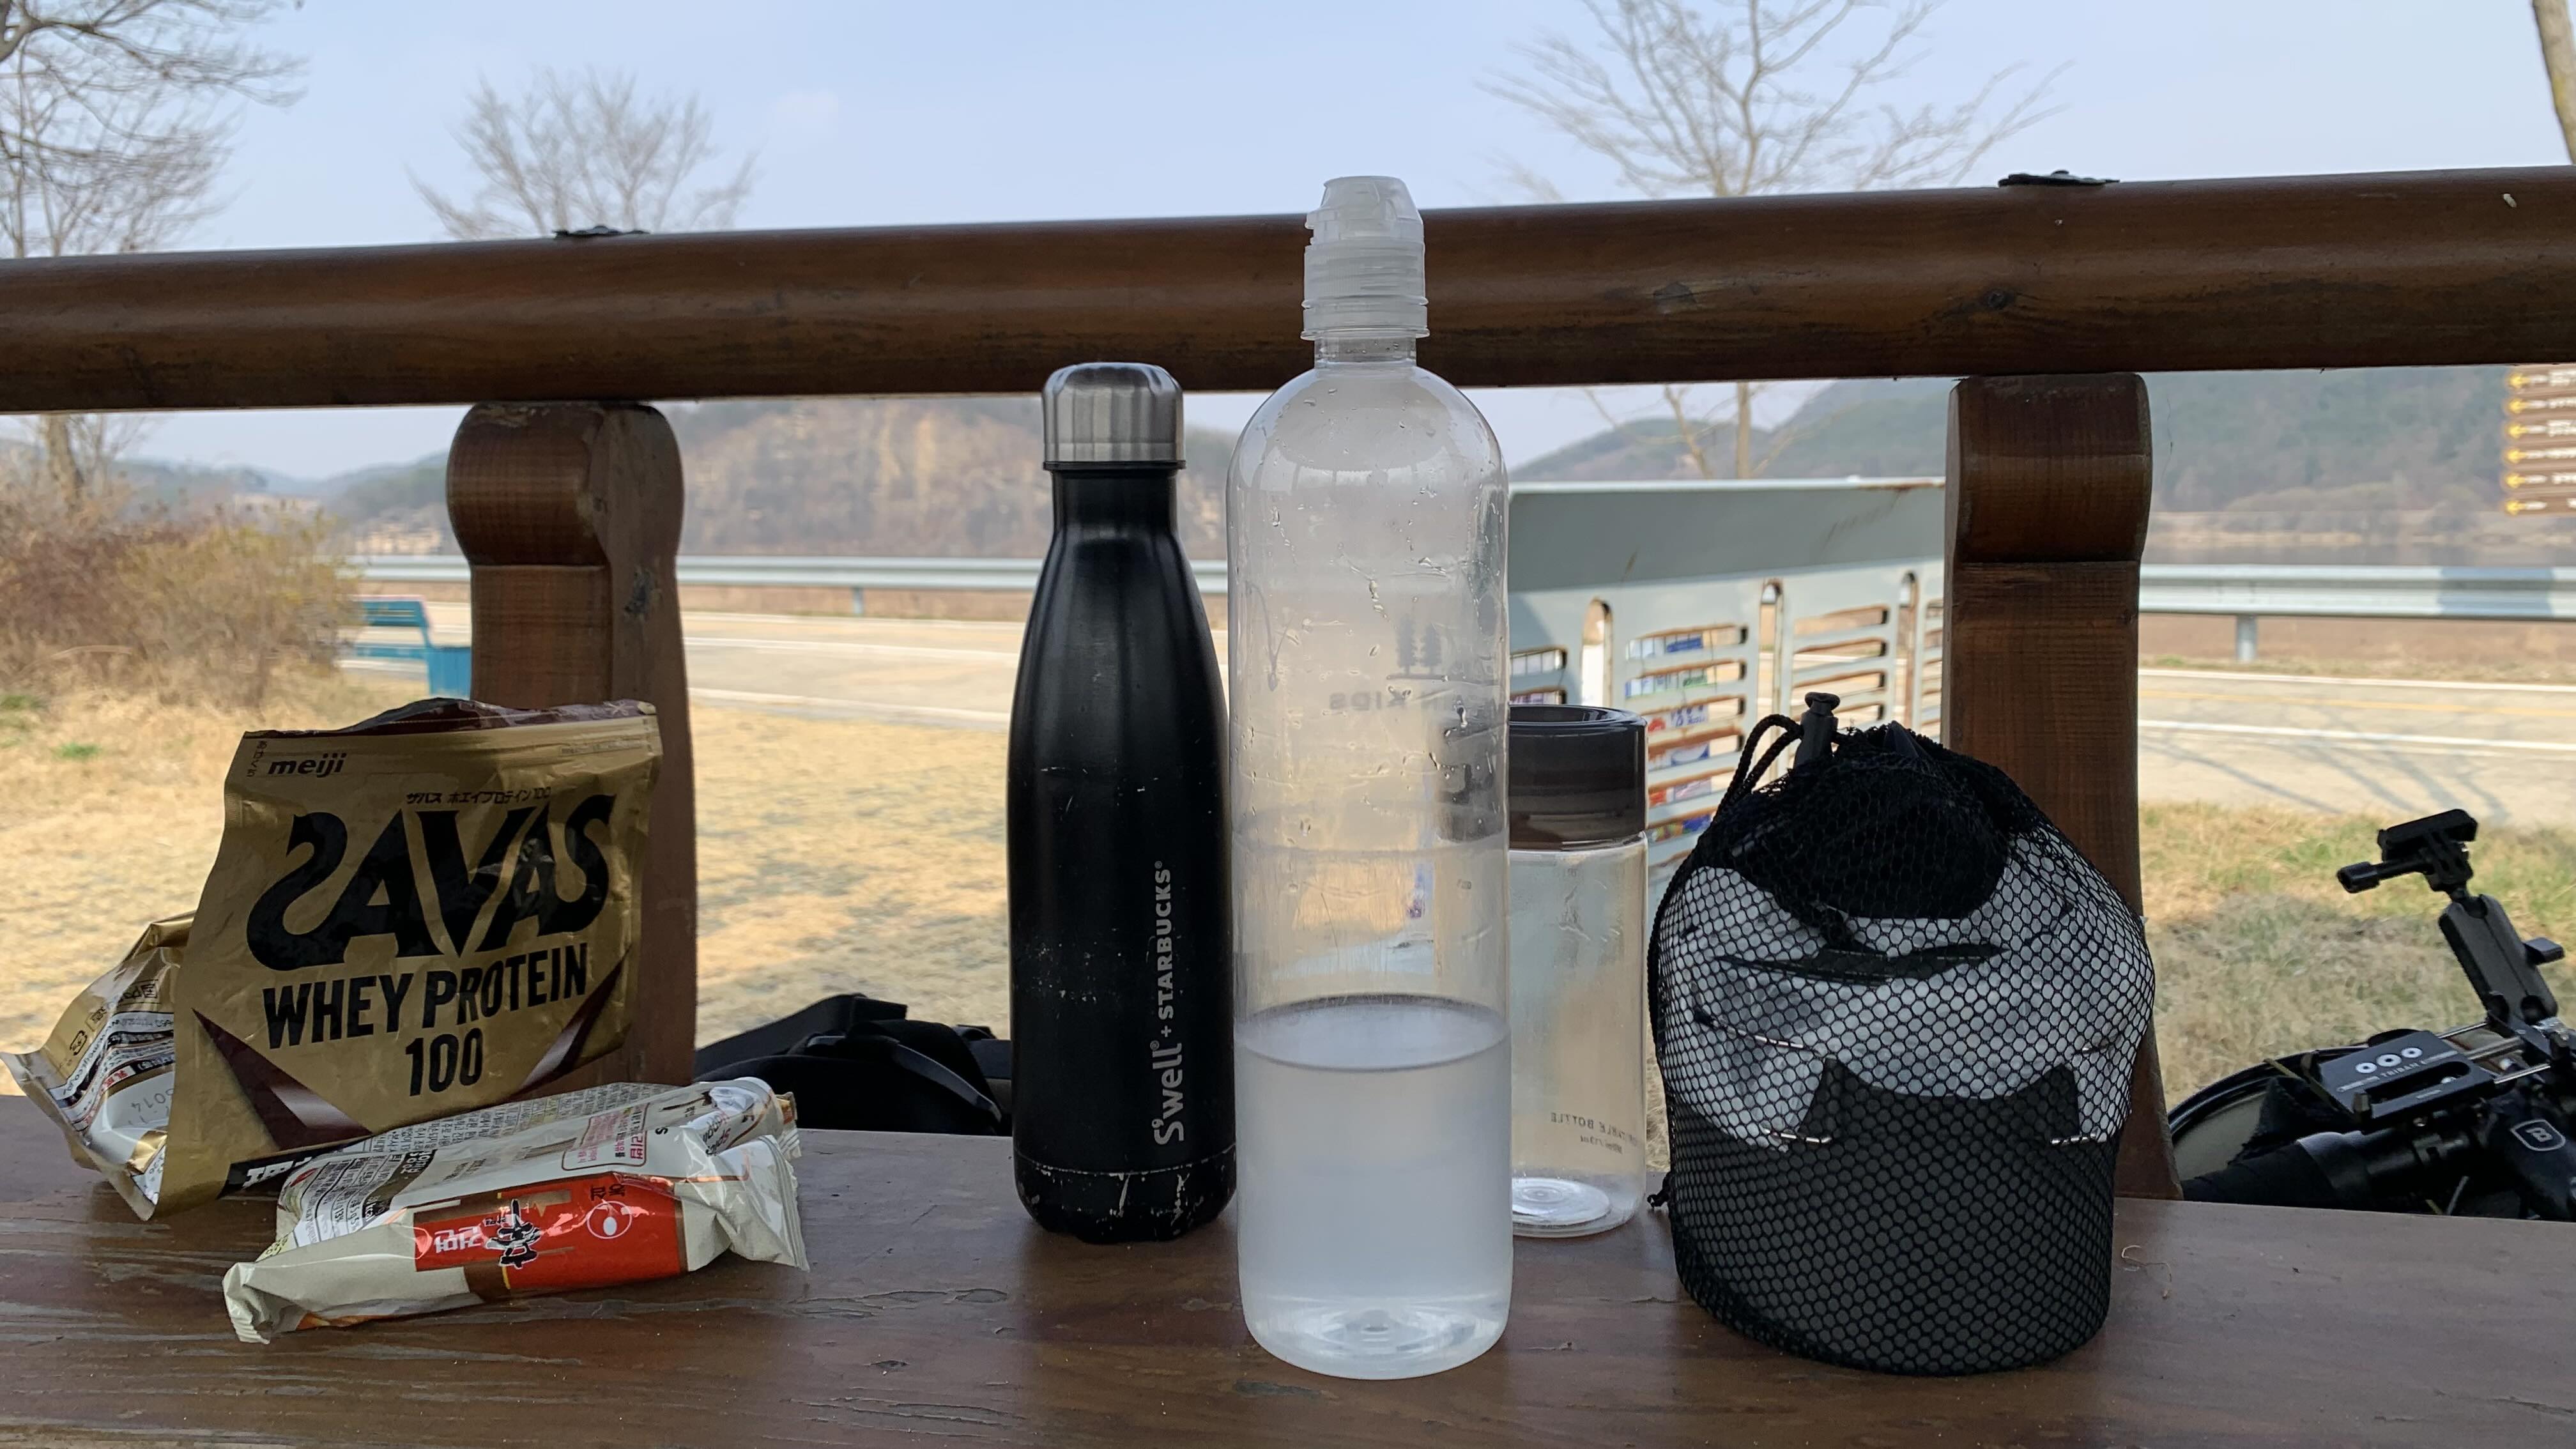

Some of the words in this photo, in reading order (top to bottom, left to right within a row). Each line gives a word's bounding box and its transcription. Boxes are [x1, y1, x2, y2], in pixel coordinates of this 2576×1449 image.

[268, 753, 347, 778] meiji
[246, 792, 617, 971] SAVAS
[263, 972, 413, 1050] WHEY
[422, 942, 587, 1029] PROTEIN
[405, 1028, 484, 1097] 100
[2380, 1062, 2421, 1077] TRIBAN
[433, 1225, 482, 1254] 건면
